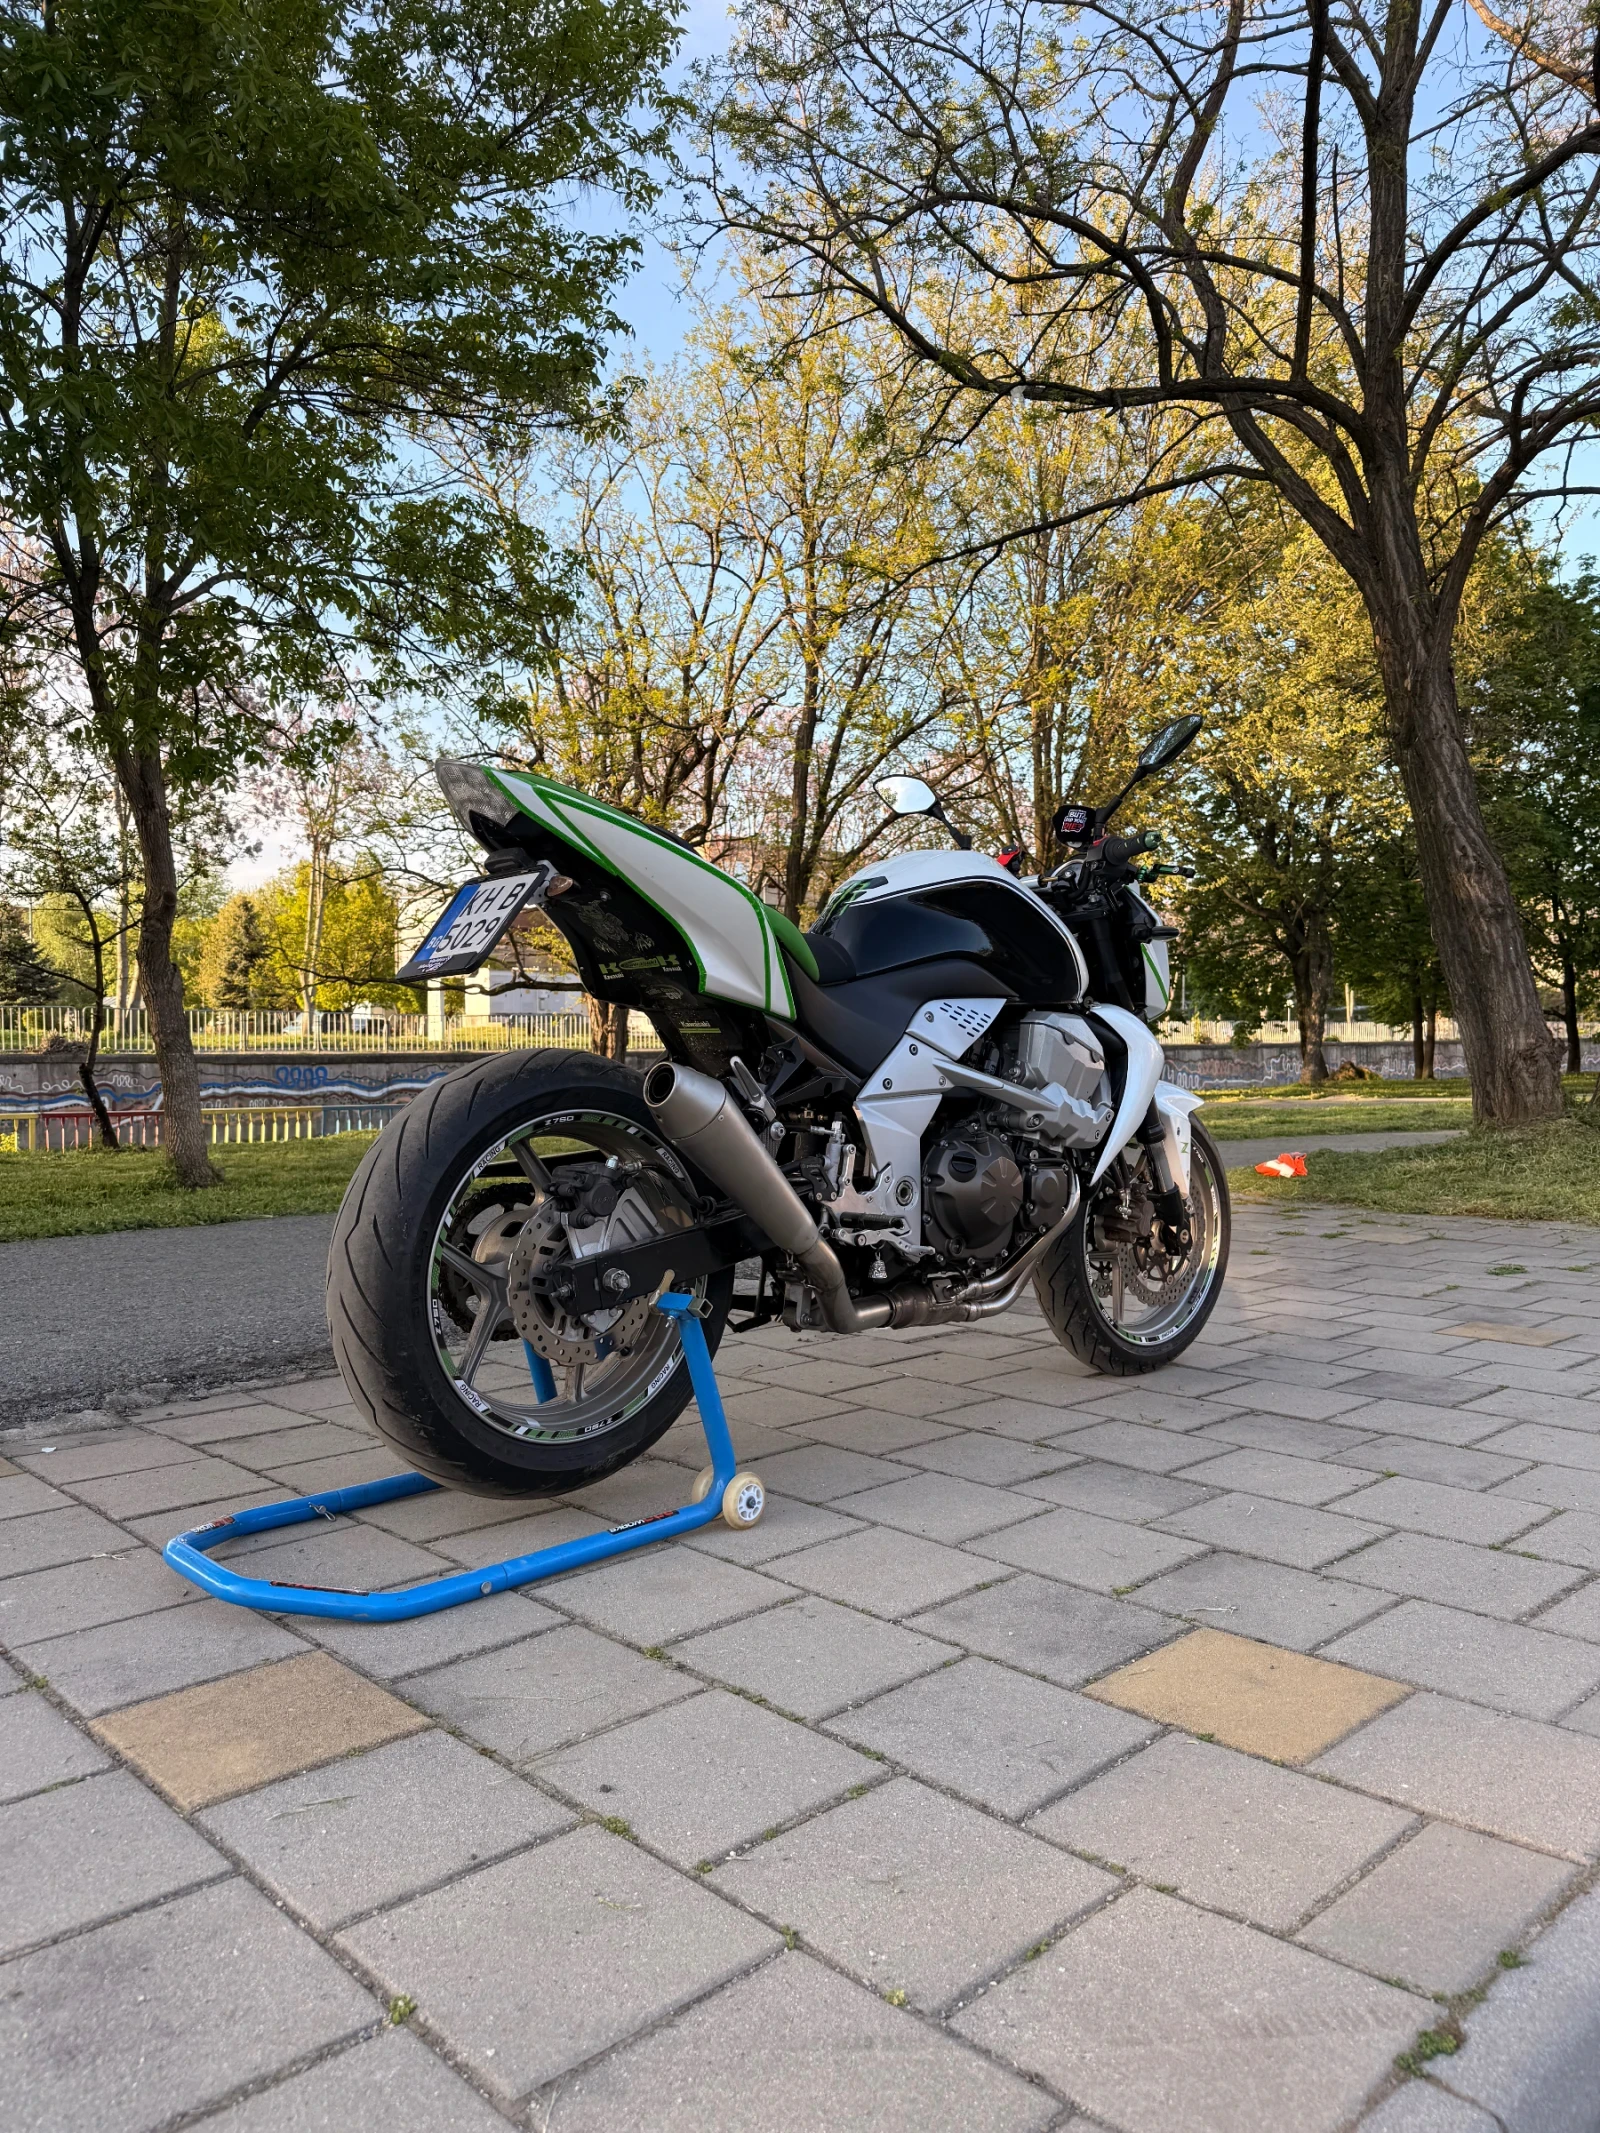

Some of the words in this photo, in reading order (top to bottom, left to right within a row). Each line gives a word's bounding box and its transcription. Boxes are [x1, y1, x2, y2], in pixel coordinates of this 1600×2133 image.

[459, 885, 505, 918] KH
[499, 882, 526, 911] B
[435, 916, 501, 953] 5029
[477, 1145, 501, 1171] RACING
[661, 1151, 680, 1174] RACING
[651, 1363, 671, 1390] RACING
[460, 1383, 483, 1409] RACING
